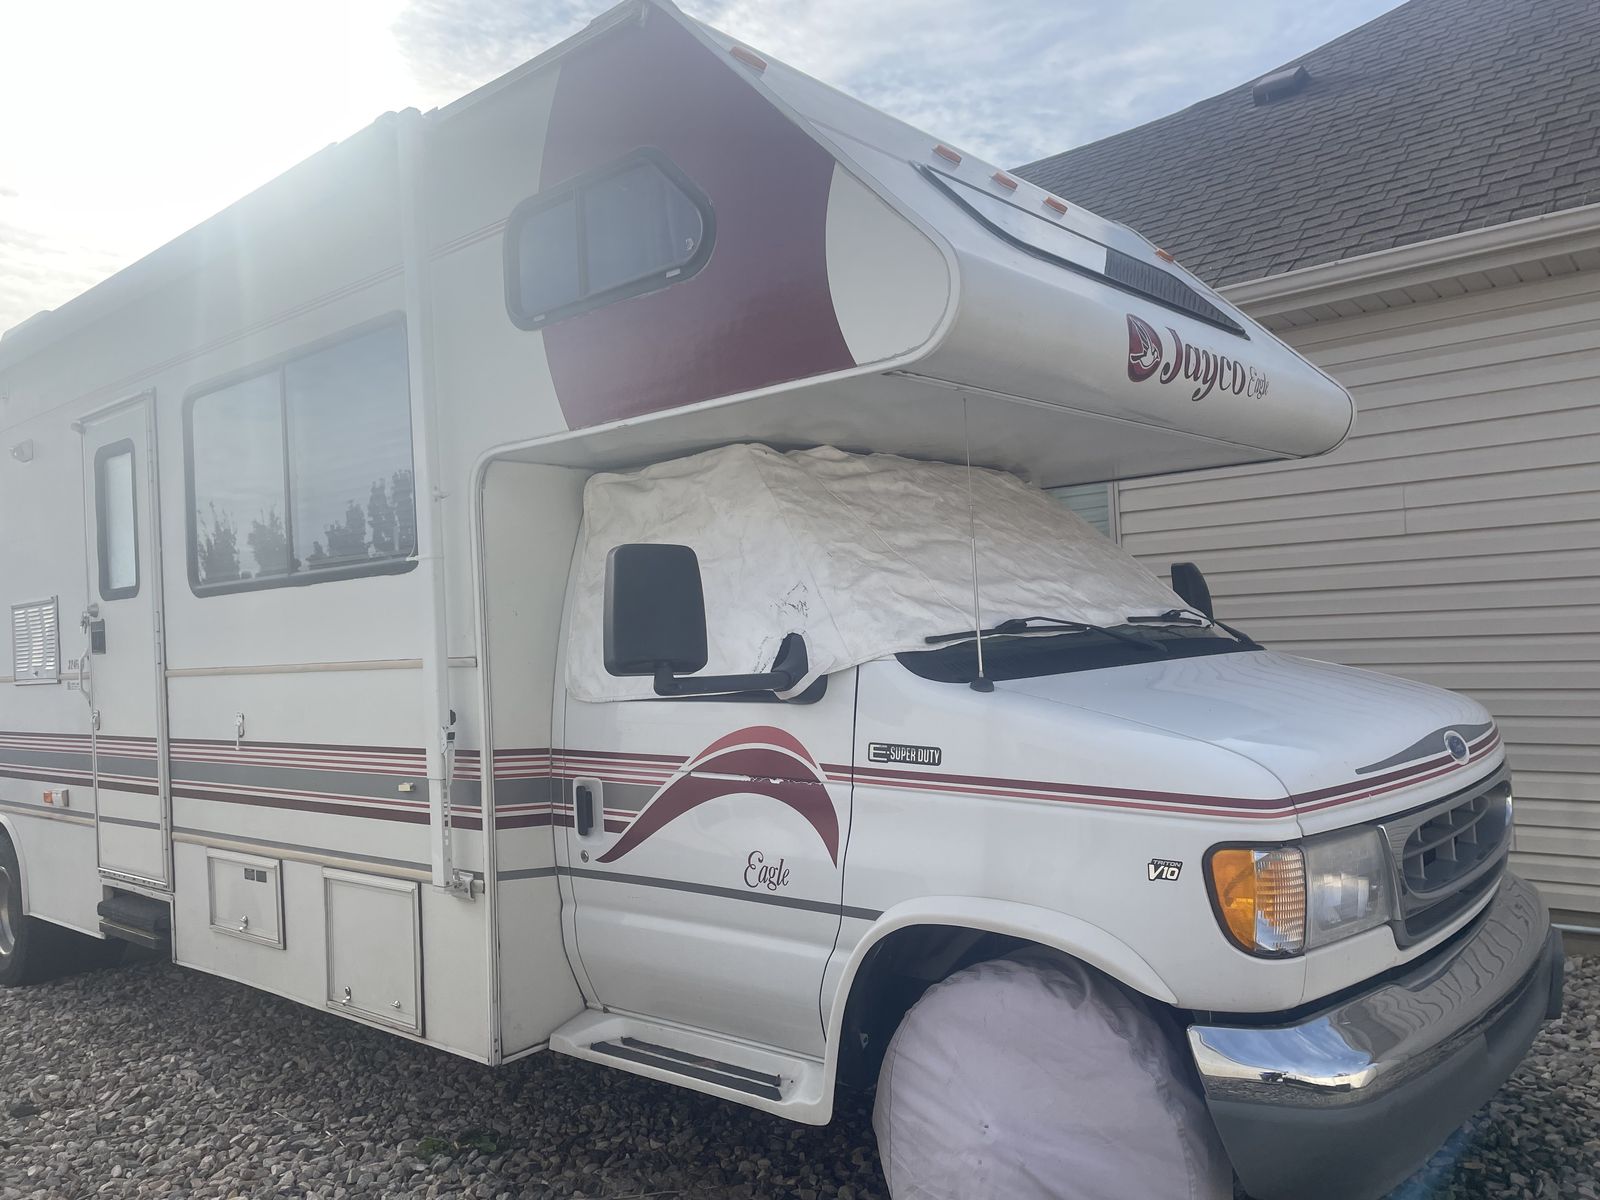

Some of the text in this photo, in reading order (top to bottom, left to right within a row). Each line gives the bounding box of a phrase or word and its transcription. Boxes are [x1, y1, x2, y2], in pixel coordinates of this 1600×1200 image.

[1160, 326, 1269, 402] Jayco Eagle
[917, 748, 940, 764] DUTY
[743, 850, 790, 891] Eagle
[1148, 863, 1180, 880] V10
